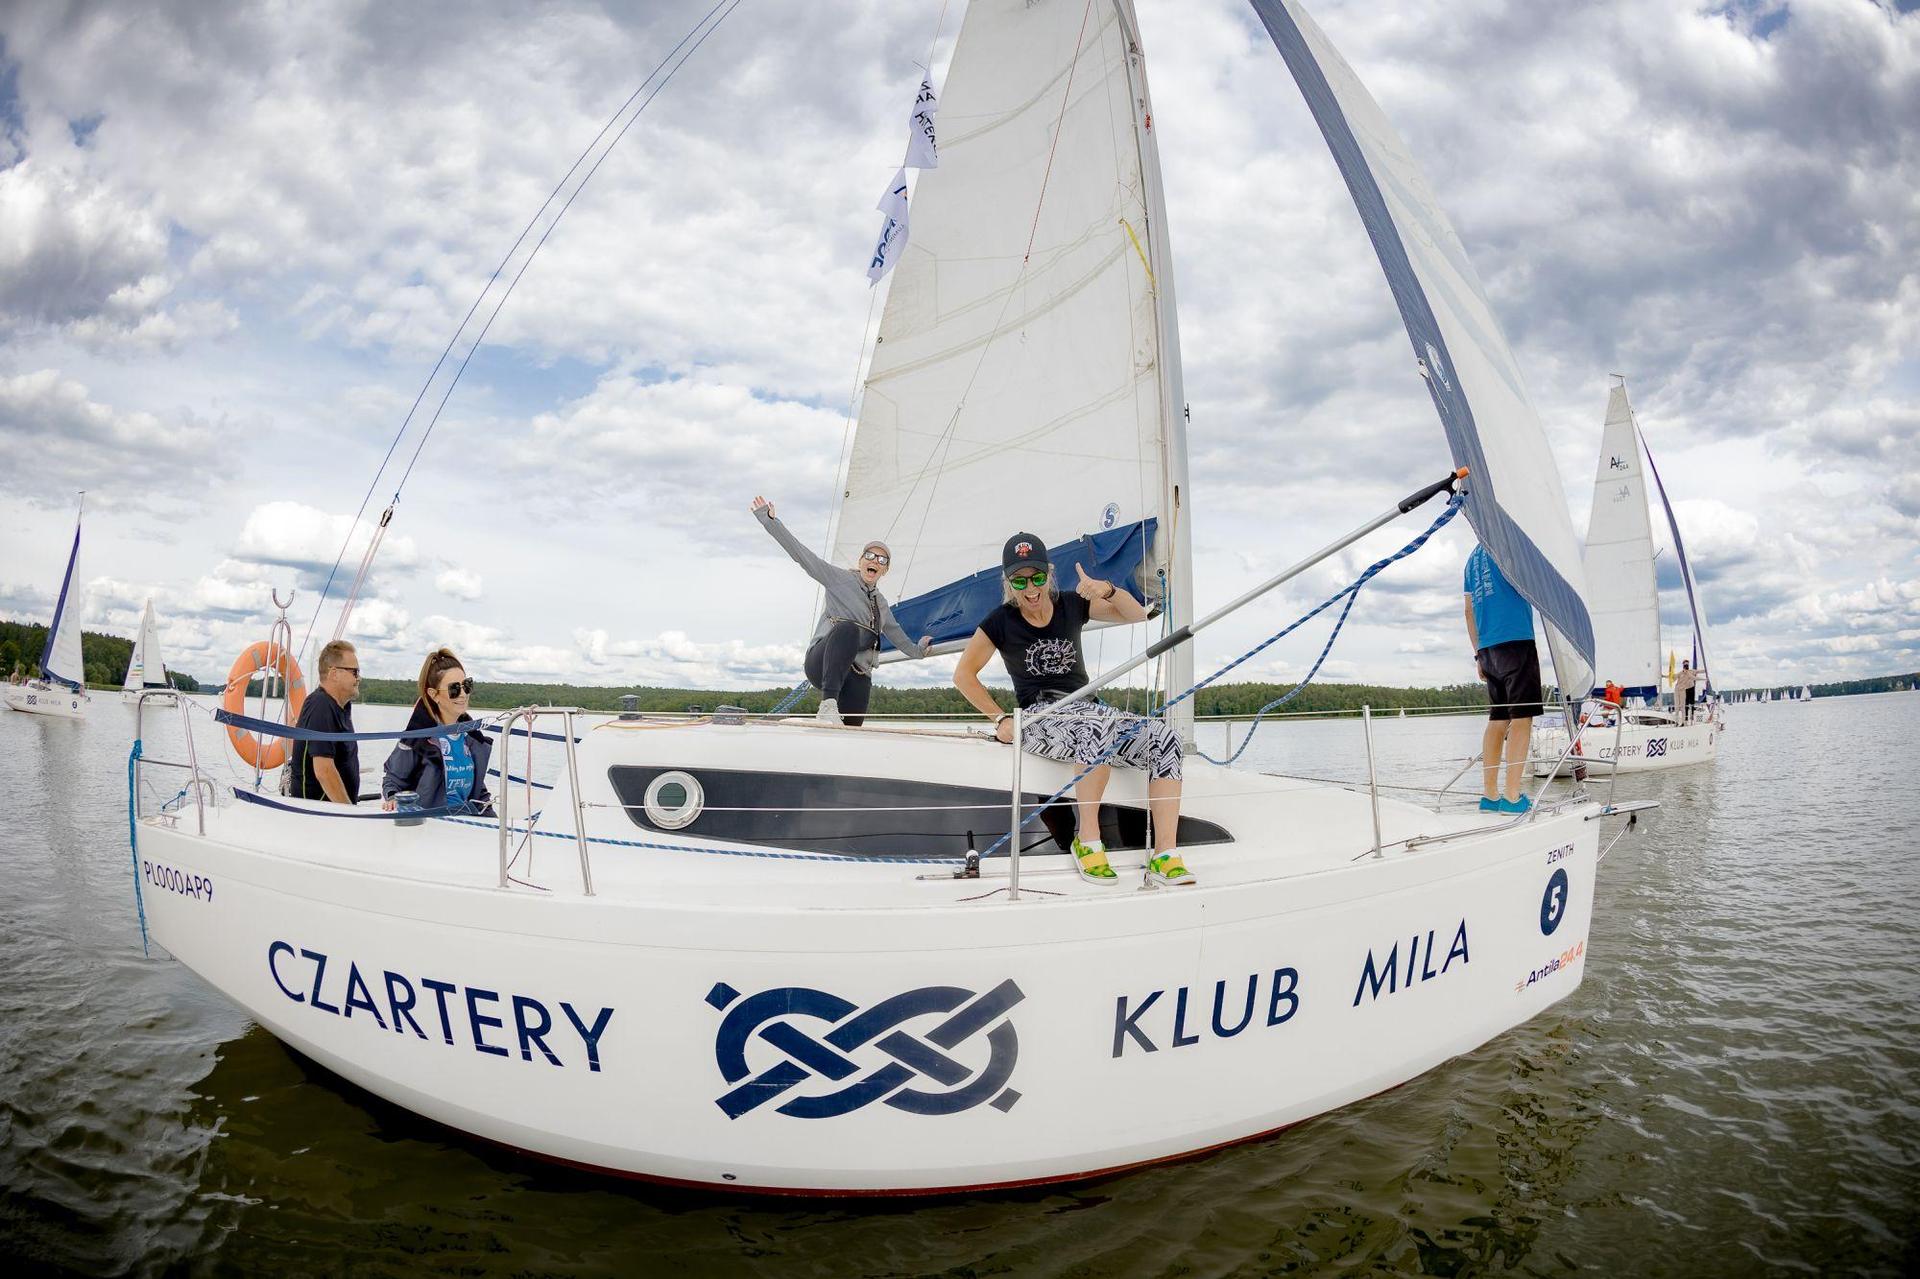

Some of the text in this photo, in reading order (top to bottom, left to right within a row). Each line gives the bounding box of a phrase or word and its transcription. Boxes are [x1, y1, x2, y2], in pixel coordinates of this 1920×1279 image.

[1598, 744, 1642, 759] CZARTERY
[1546, 842, 1574, 865] ZENITH
[1547, 885, 1561, 921] 5
[267, 917, 1469, 1072] CZARTERY KLUB MILA
